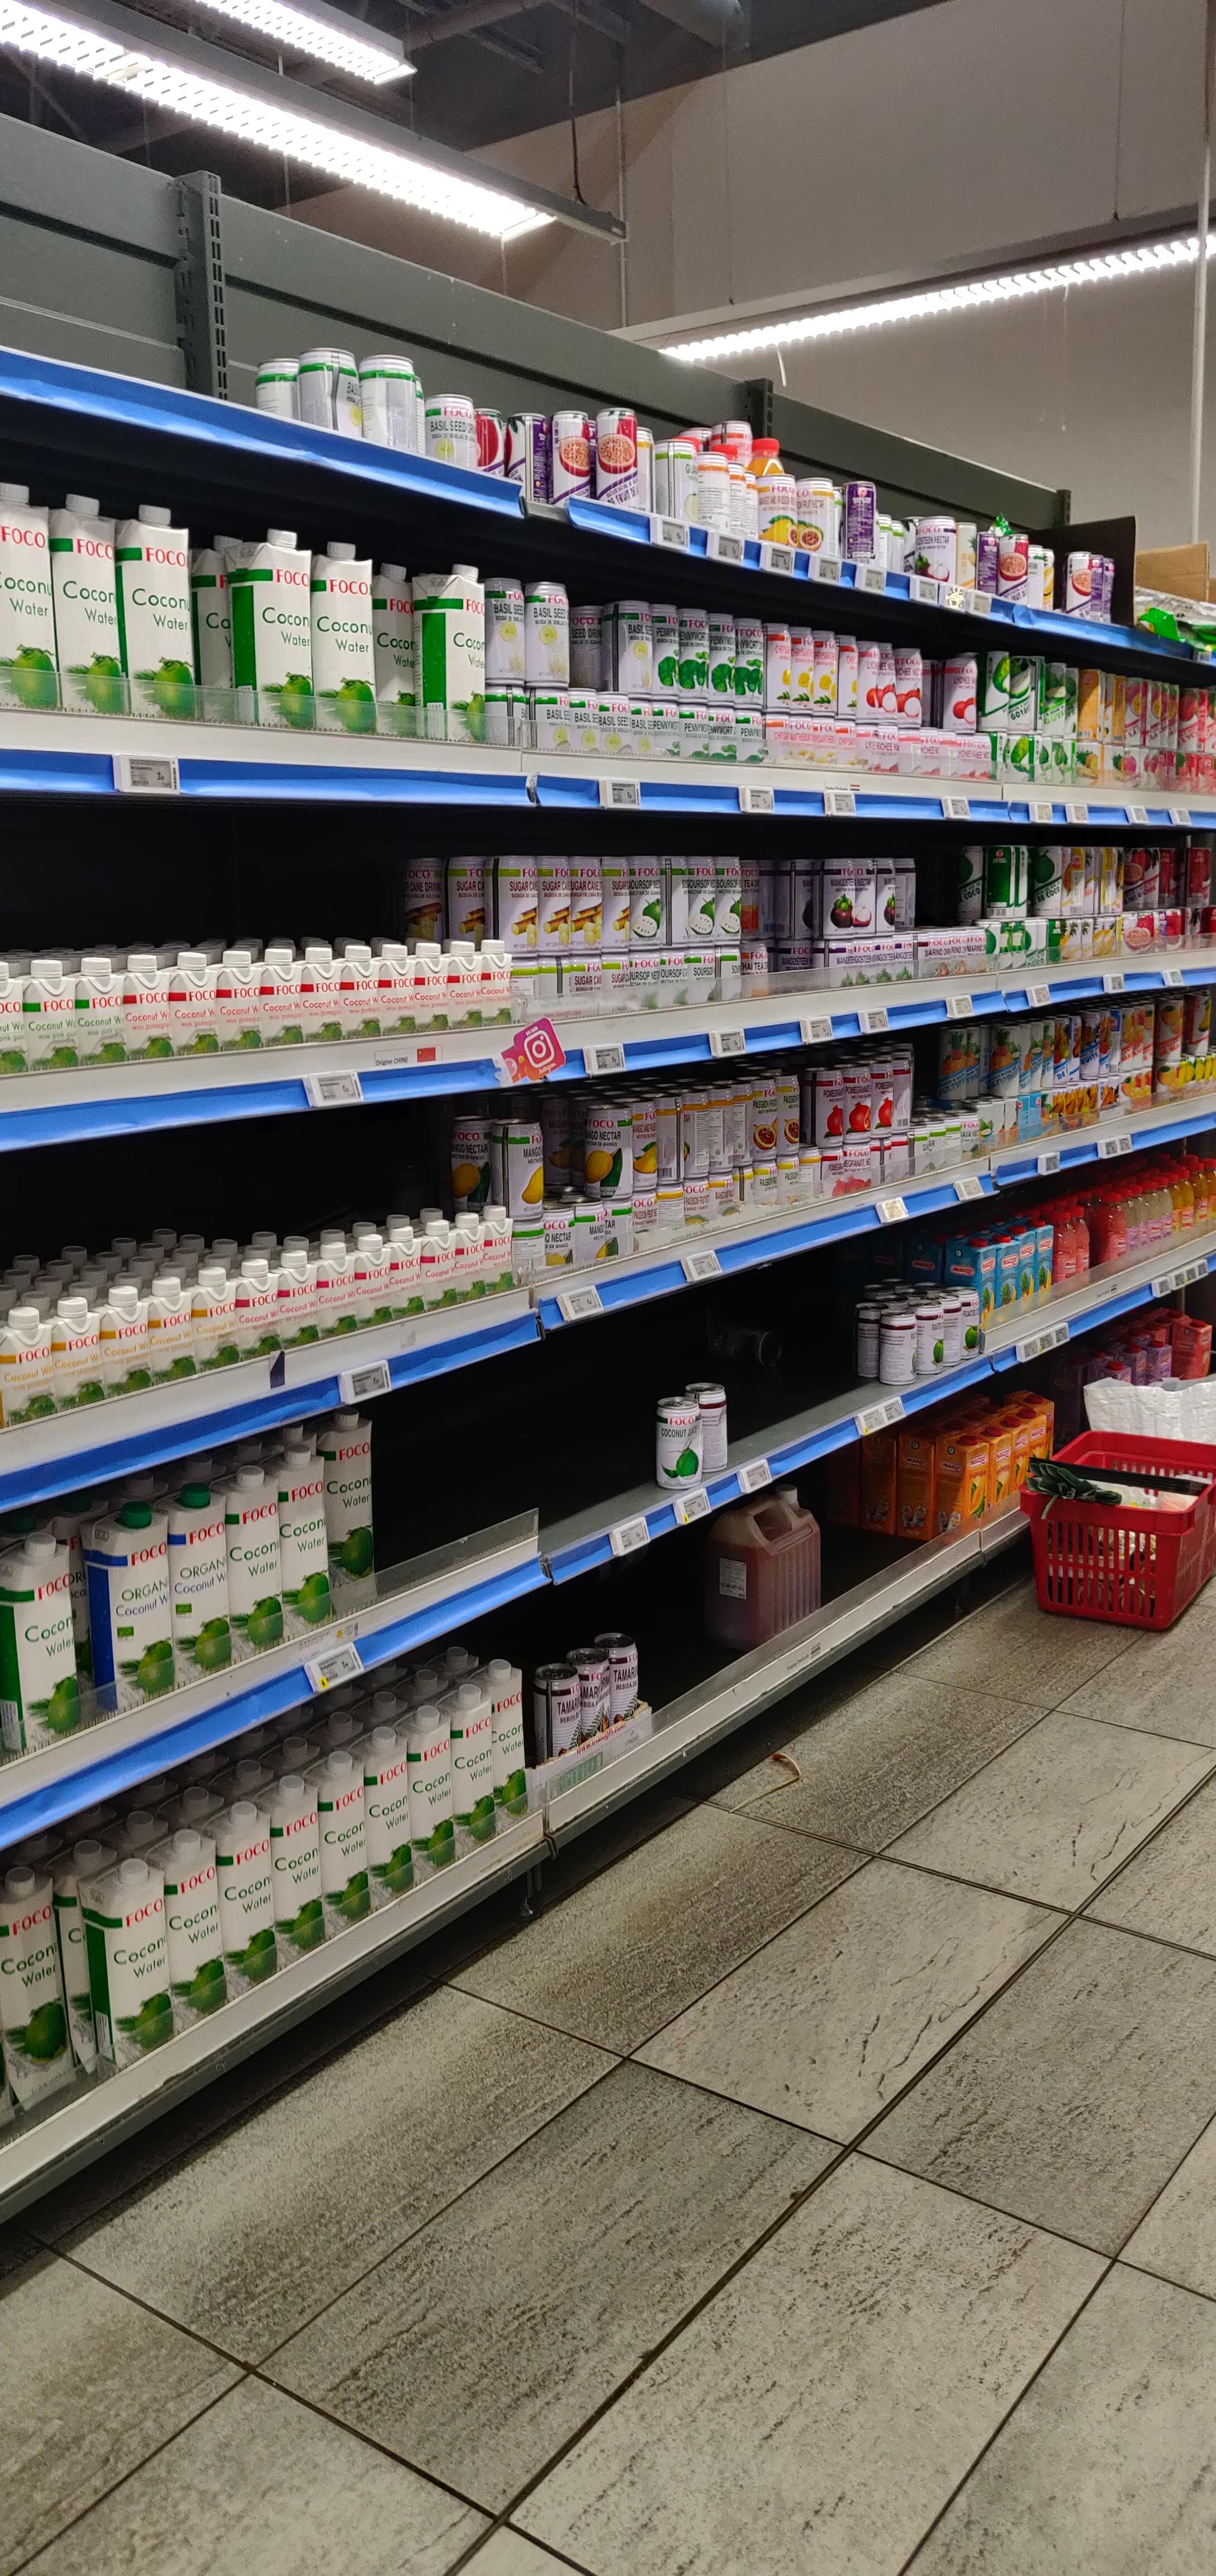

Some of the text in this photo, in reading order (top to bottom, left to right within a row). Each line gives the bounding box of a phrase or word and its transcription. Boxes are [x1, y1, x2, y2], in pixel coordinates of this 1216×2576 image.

[444, 406, 472, 418] FOCO
[430, 421, 466, 432] BASIL SEED
[1, 526, 46, 548] FOCO
[146, 547, 186, 567] FOCO
[330, 580, 368, 595] FOCO
[10, 598, 48, 617] Water
[494, 603, 512, 614] BASIL
[534, 608, 552, 618] BASIL
[153, 613, 188, 631] Water
[571, 628, 586, 638] SEED
[628, 624, 644, 634] BASIL
[281, 631, 310, 647] Water
[335, 639, 369, 652] Water
[547, 709, 563, 719] BASIL
[575, 713, 591, 723] BASIL
[631, 719, 646, 729] BASIL
[457, 881, 475, 891] SUGAR
[510, 881, 528, 892] SUGAR
[542, 881, 560, 891] SUGAR
[716, 879, 738, 888] SOURSOP
[635, 959, 658, 968] FOCO
[574, 976, 592, 986] SUGAR
[234, 987, 260, 999] FOCO
[277, 985, 300, 996] FOCO
[316, 982, 340, 993] FOCO
[450, 989, 475, 998] Coconut
[481, 987, 505, 996] Coconut
[139, 992, 168, 1004] FOCO
[189, 989, 216, 1001] FOCO
[381, 995, 407, 1005] Coconut
[415, 992, 442, 1001] Coconut
[43, 999, 73, 1012] FOCO
[92, 996, 122, 1008] FOCO
[263, 1001, 292, 1012] Coconut
[303, 999, 332, 1010] Coconut
[344, 997, 370, 1007] Coconut
[126, 1010, 155, 1022] Coconut
[174, 1008, 205, 1020] Coconut
[220, 1005, 249, 1016] Coconut
[28, 1020, 64, 1031] Coconut
[78, 1016, 112, 1028] Coconut
[588, 1120, 614, 1128] FOCO
[599, 1131, 621, 1140] NECTAR
[466, 1144, 488, 1154] NECTAR
[524, 1148, 540, 1158] MANGO
[551, 1232, 571, 1243] NECTAR
[483, 1251, 505, 1261] Coconut
[454, 1258, 478, 1270] Coconut
[368, 1266, 390, 1280] FOCO
[425, 1268, 448, 1278] Coconut
[331, 1275, 354, 1287] FOCO
[390, 1275, 415, 1286] Coconut
[292, 1284, 316, 1297] FOCO
[356, 1284, 383, 1296] Coconut
[252, 1292, 277, 1306] FOCO
[319, 1292, 347, 1304] Coconut
[210, 1302, 236, 1317] FOCO
[279, 1302, 309, 1314] Coconut
[163, 1312, 191, 1328] FOCO
[239, 1313, 268, 1324] Coconut
[118, 1323, 147, 1339] FOCO
[196, 1323, 226, 1334] Coconut
[68, 1334, 98, 1351] FOCO
[150, 1332, 180, 1345] Coconut
[18, 1346, 49, 1363] FOCO
[104, 1344, 139, 1357] Coconut
[55, 1356, 89, 1369] Coconut
[4, 1367, 39, 1382] Coconut
[661, 1428, 686, 1437] COCONUT
[339, 1442, 370, 1461] FOCO
[291, 1481, 323, 1502] FOCO
[343, 1493, 370, 1508] Water
[243, 1502, 277, 1524] FOCO
[189, 1521, 224, 1545] FOCO
[298, 1536, 325, 1553] Water
[131, 1541, 167, 1566] FOCO
[248, 1559, 278, 1577] Water
[37, 1573, 70, 1600] FOCO
[174, 1577, 215, 1594] Coconut
[116, 1597, 158, 1618] Coconut
[497, 1692, 521, 1712] FOCO
[465, 1716, 491, 1738] FOCO
[424, 1738, 450, 1762] FOCO
[502, 1739, 524, 1756] Water
[380, 1760, 407, 1784] FOCO
[469, 1764, 492, 1782] Water
[335, 1785, 364, 1811] FOCO
[428, 1788, 451, 1807] Water
[286, 1811, 317, 1836] FOCO
[236, 1838, 269, 1865] FOCO
[180, 1867, 215, 1893] FOCO
[243, 1893, 272, 1914] Water
[126, 1897, 163, 1927] FOCO
[12, 1905, 52, 1935] FOCO
[188, 1922, 218, 1944] Water
[133, 1956, 165, 1979] Water
